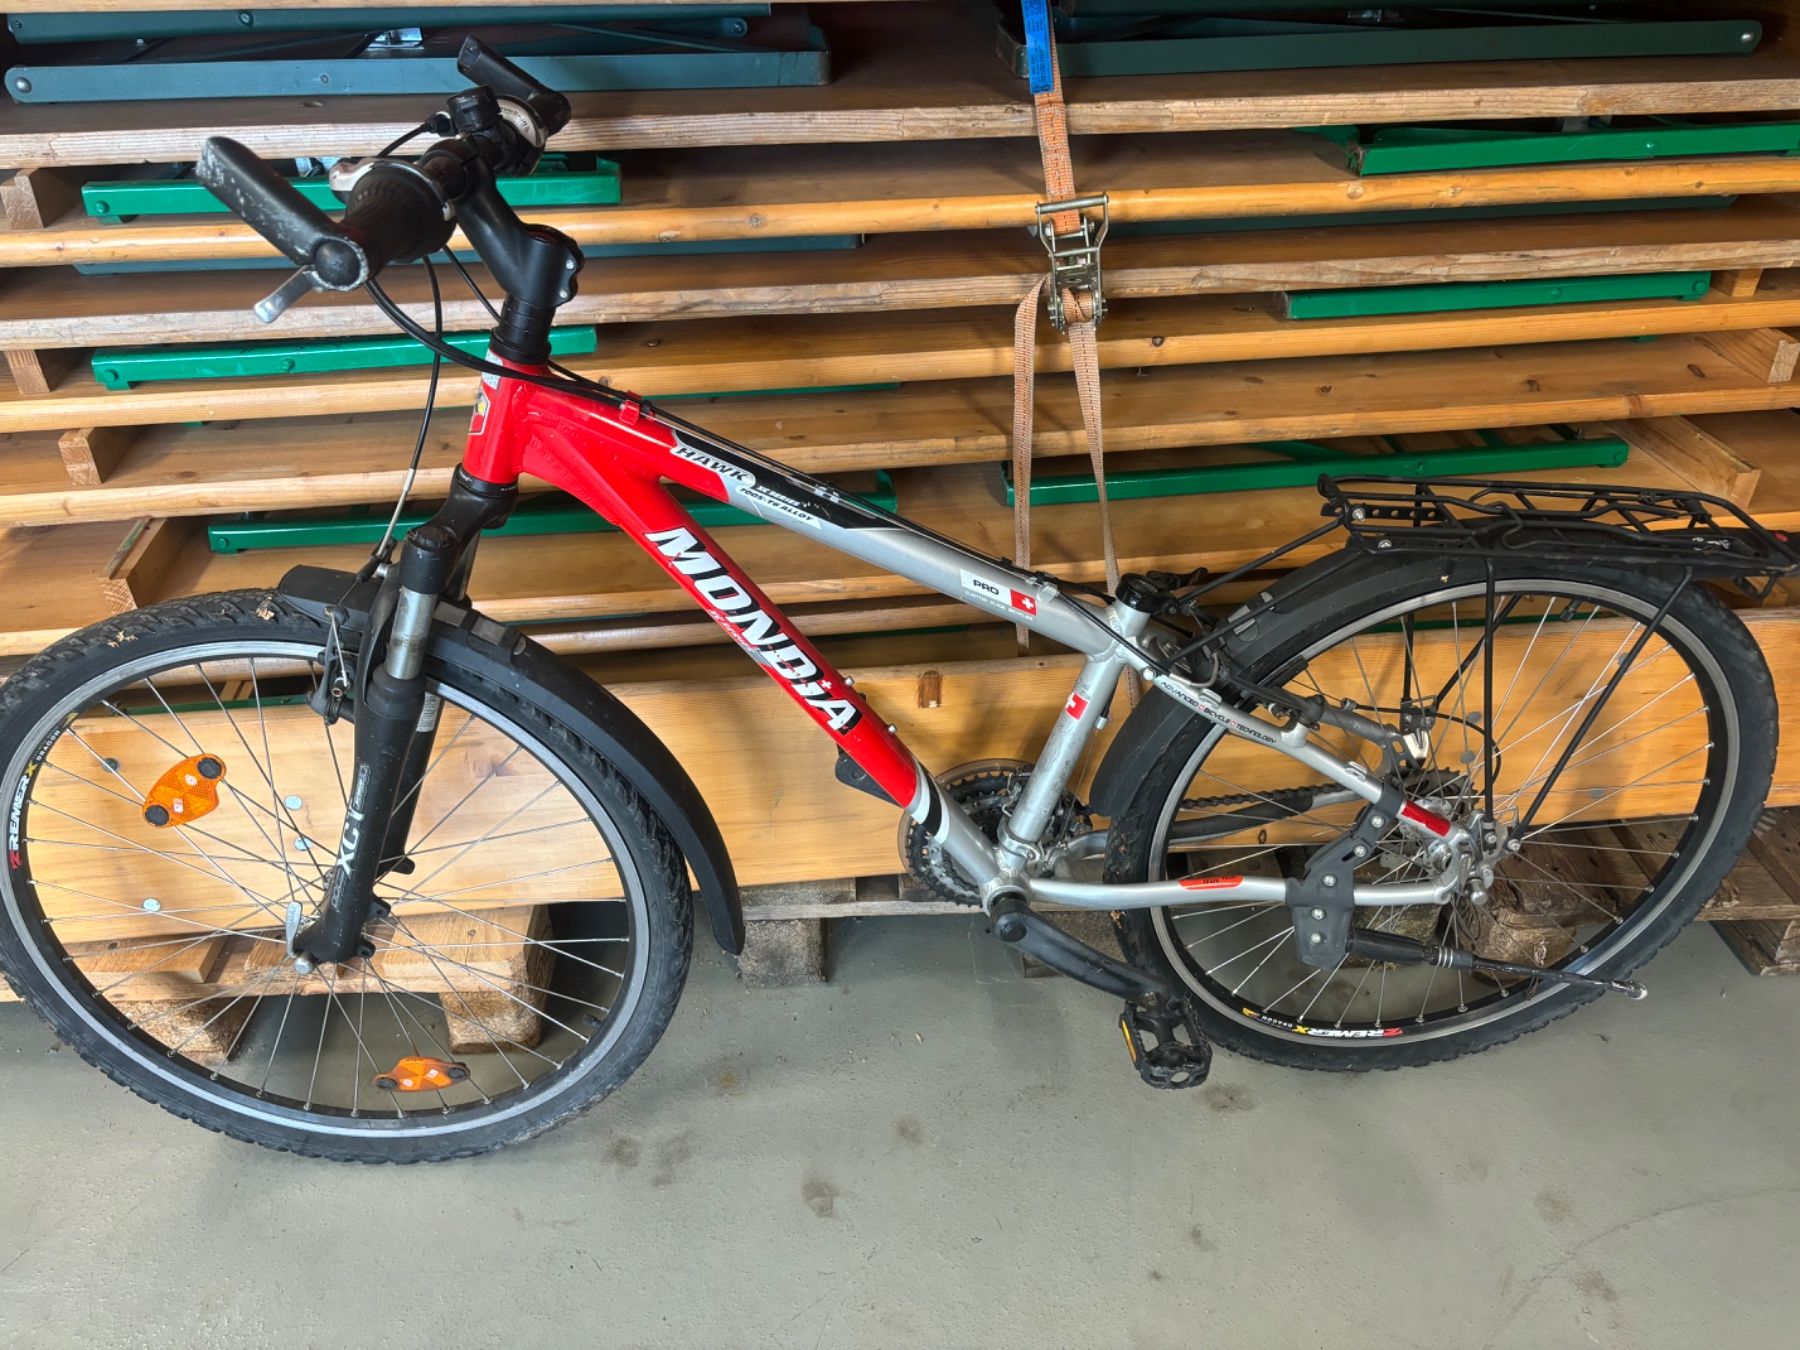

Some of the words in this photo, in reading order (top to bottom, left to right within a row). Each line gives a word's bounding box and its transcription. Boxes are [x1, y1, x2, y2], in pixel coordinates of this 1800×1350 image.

[676, 447, 748, 482] HAWK
[779, 503, 814, 521] ALLOY
[973, 579, 1000, 595] PRO
[1161, 681, 1200, 706] ADVANCED
[1203, 707, 1231, 724] BICYCLE
[1236, 723, 1277, 744] TECHNOLOGY
[36, 729, 62, 762] DRAGON
